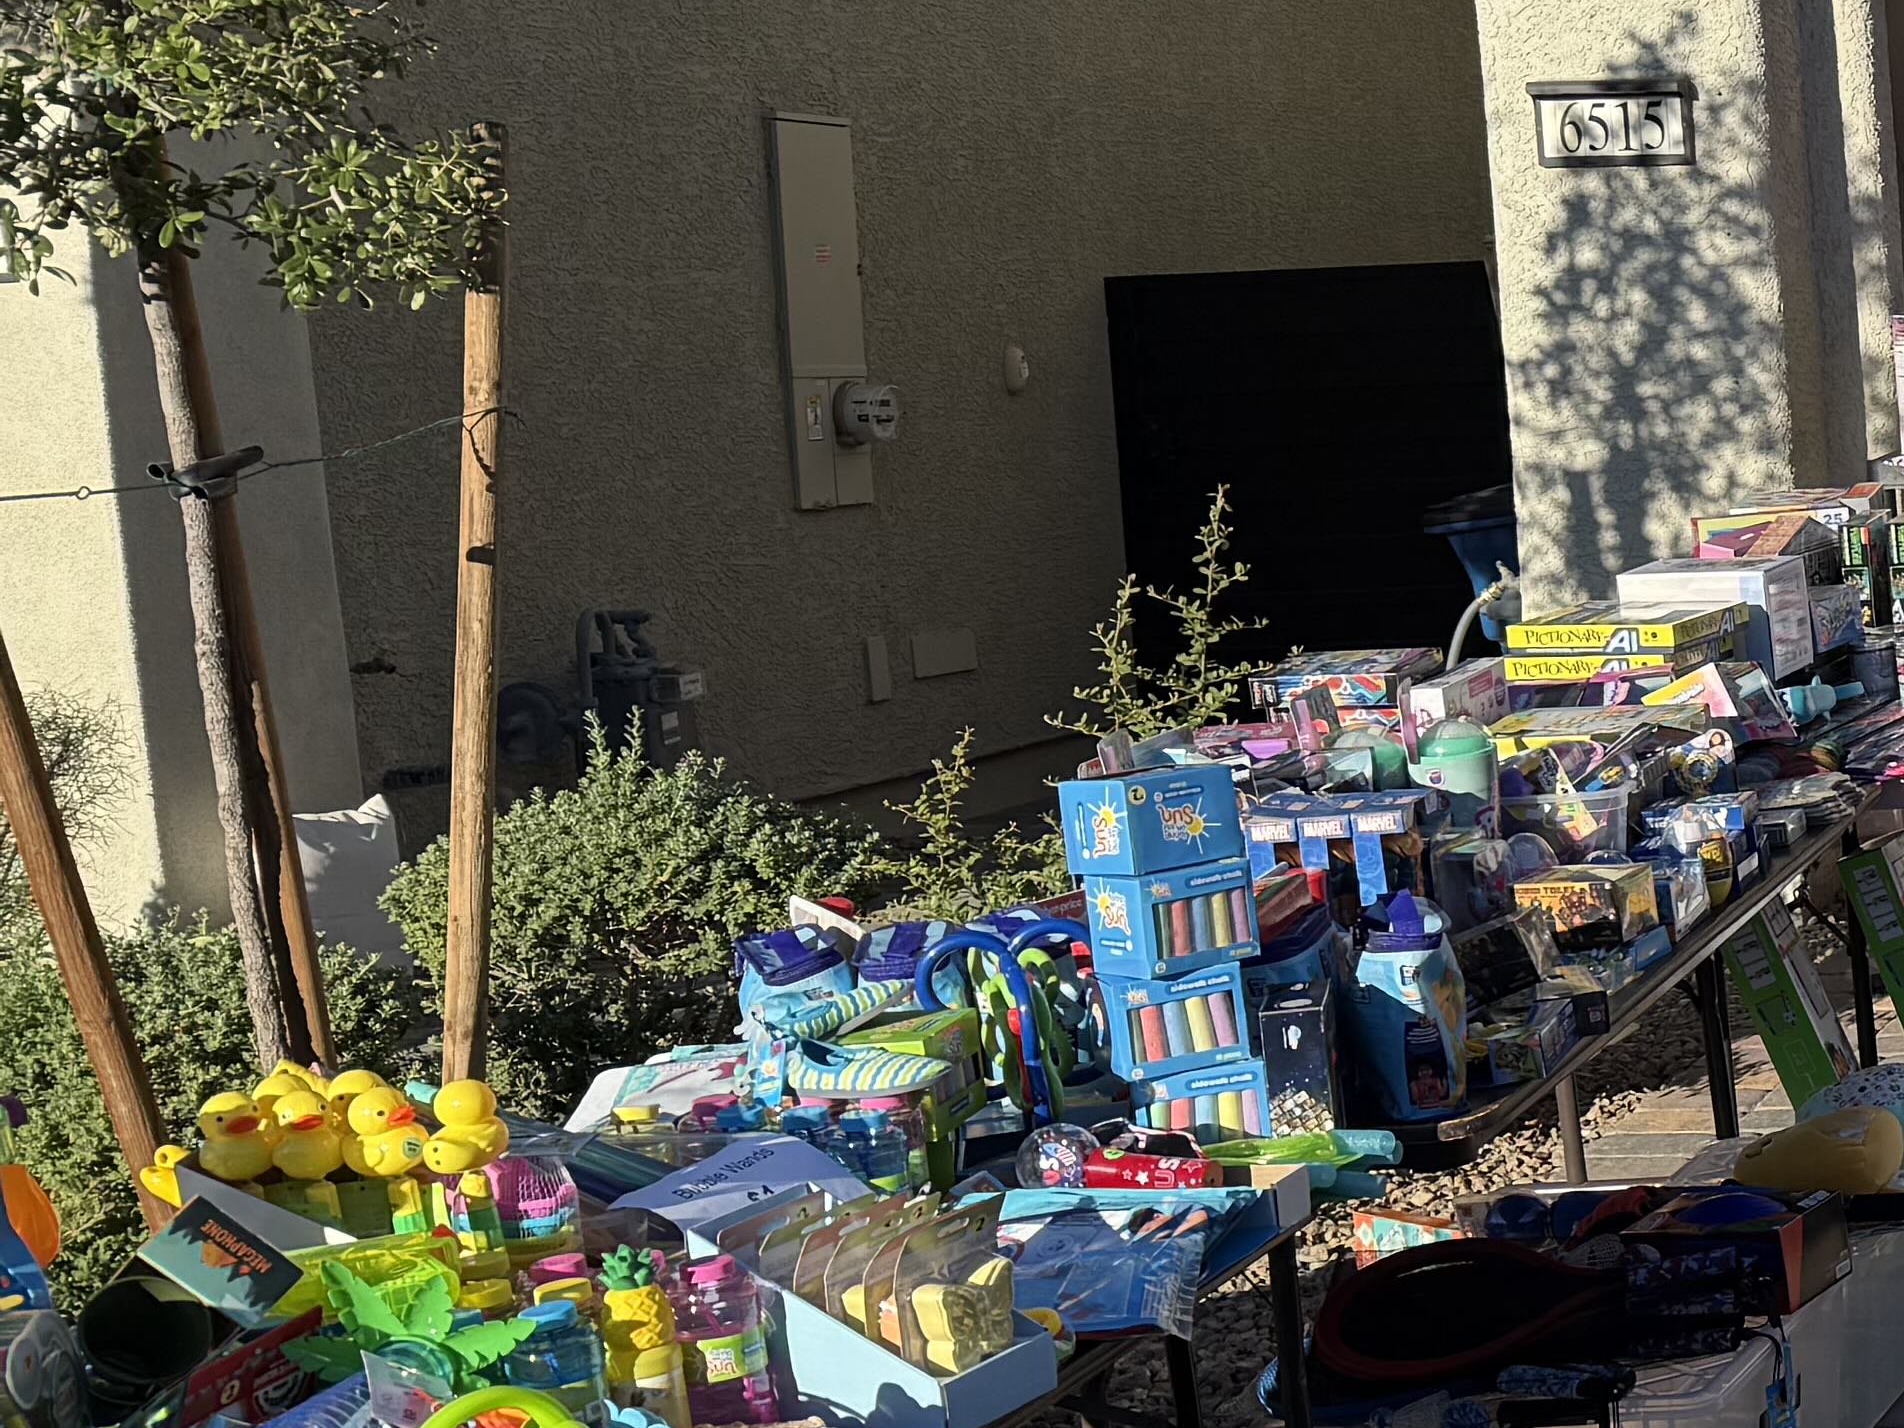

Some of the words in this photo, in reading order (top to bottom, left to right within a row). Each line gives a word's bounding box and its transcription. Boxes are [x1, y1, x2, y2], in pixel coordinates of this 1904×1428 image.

[1560, 100, 1665, 153] 6515
[1524, 628, 1602, 646] PICTIONARY
[1604, 629, 1639, 653] AI
[1512, 659, 1593, 677] PICTIONARY
[1250, 825, 1291, 842] MARVEL
[1303, 820, 1344, 838] MARVEL
[1356, 813, 1398, 833] MARVEL
[672, 1165, 727, 1201] Bubble
[727, 1146, 776, 1173] Wands
[201, 1219, 272, 1274] MEGAPHONE
